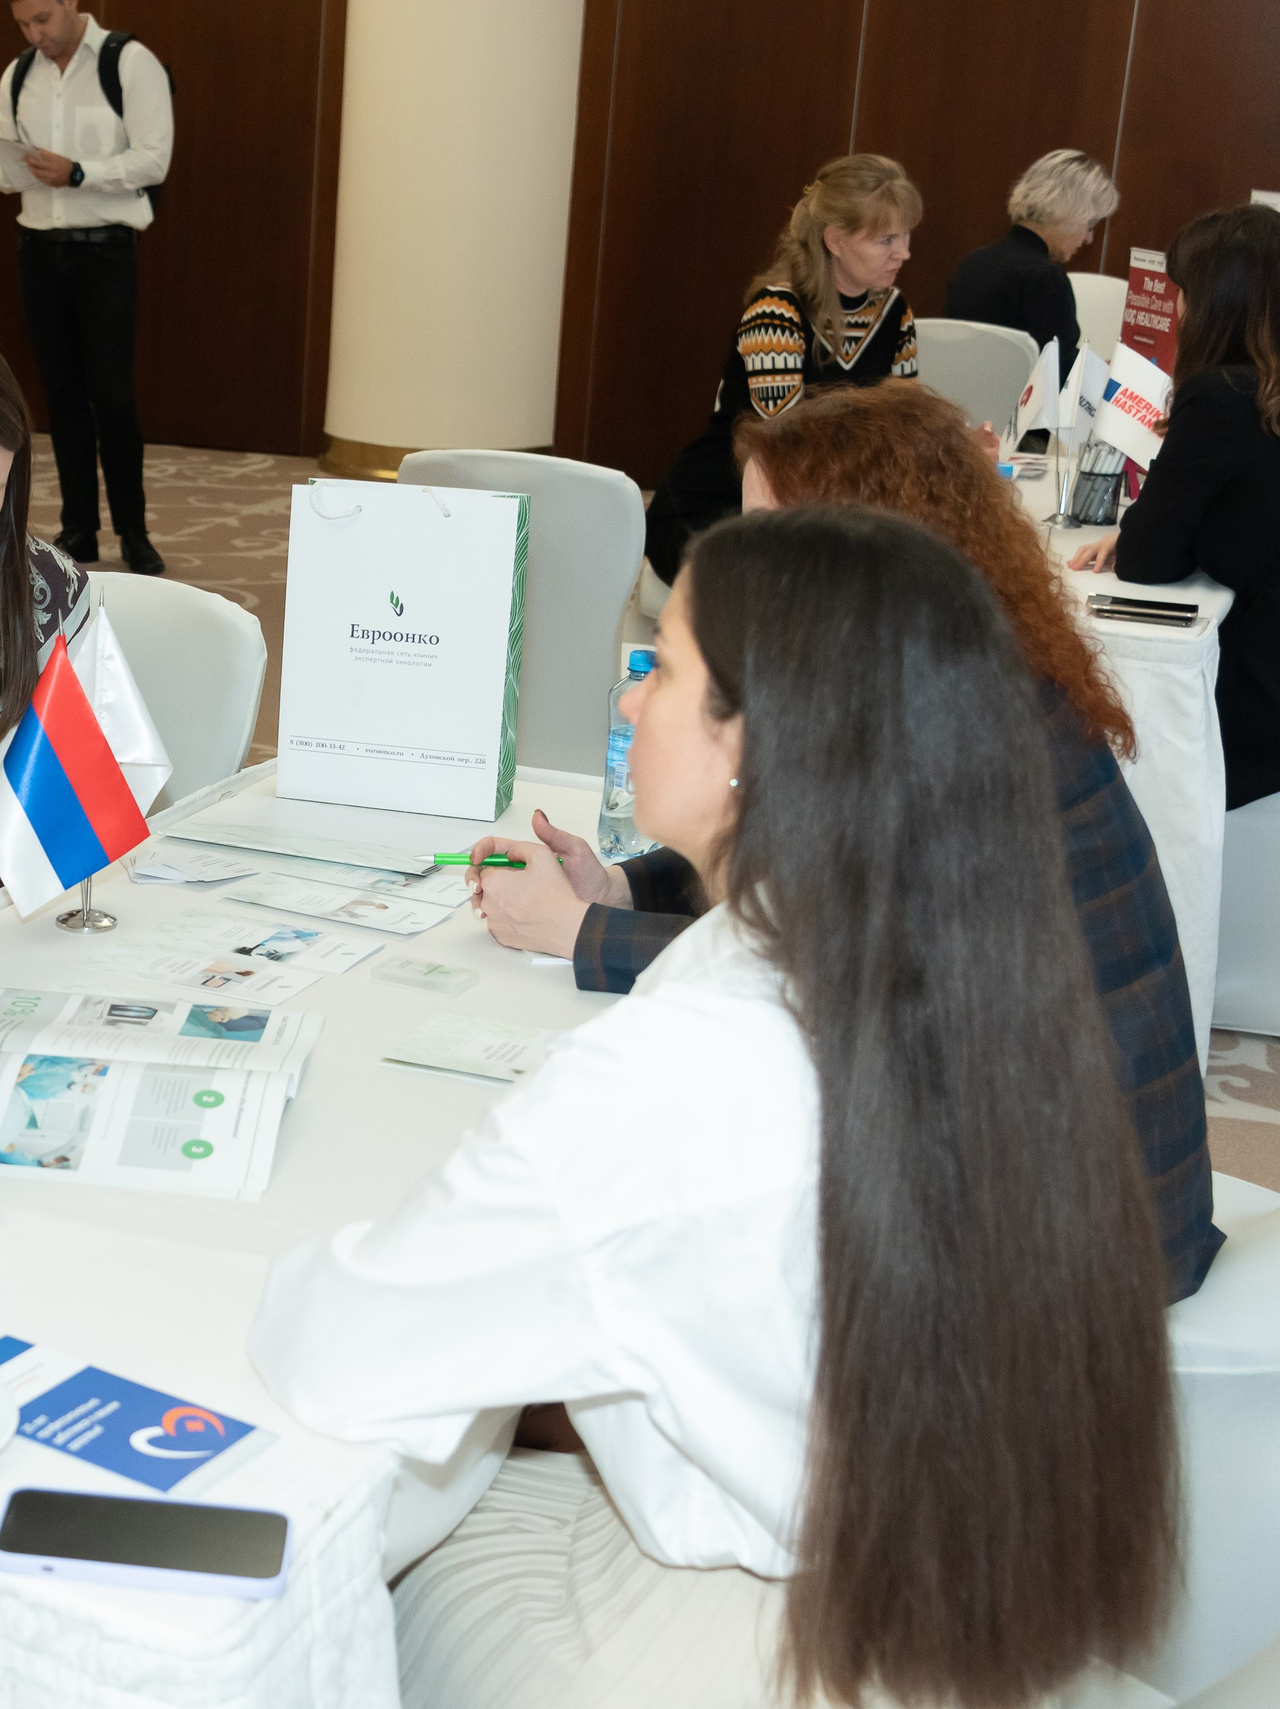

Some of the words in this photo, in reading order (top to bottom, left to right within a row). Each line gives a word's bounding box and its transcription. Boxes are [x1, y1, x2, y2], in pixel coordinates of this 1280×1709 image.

[1118, 387, 1164, 420] AMERIK
[1111, 395, 1155, 430] HASTAN
[349, 623, 440, 646] Евроонко
[349, 646, 395, 656] федеральная
[396, 650, 411, 658] сеть
[354, 655, 393, 664] экспертной
[395, 659, 432, 668] онкологии
[295, 740, 313, 748] (800)
[365, 748, 404, 757] euroonco.ru
[419, 752, 455, 762] Духовской
